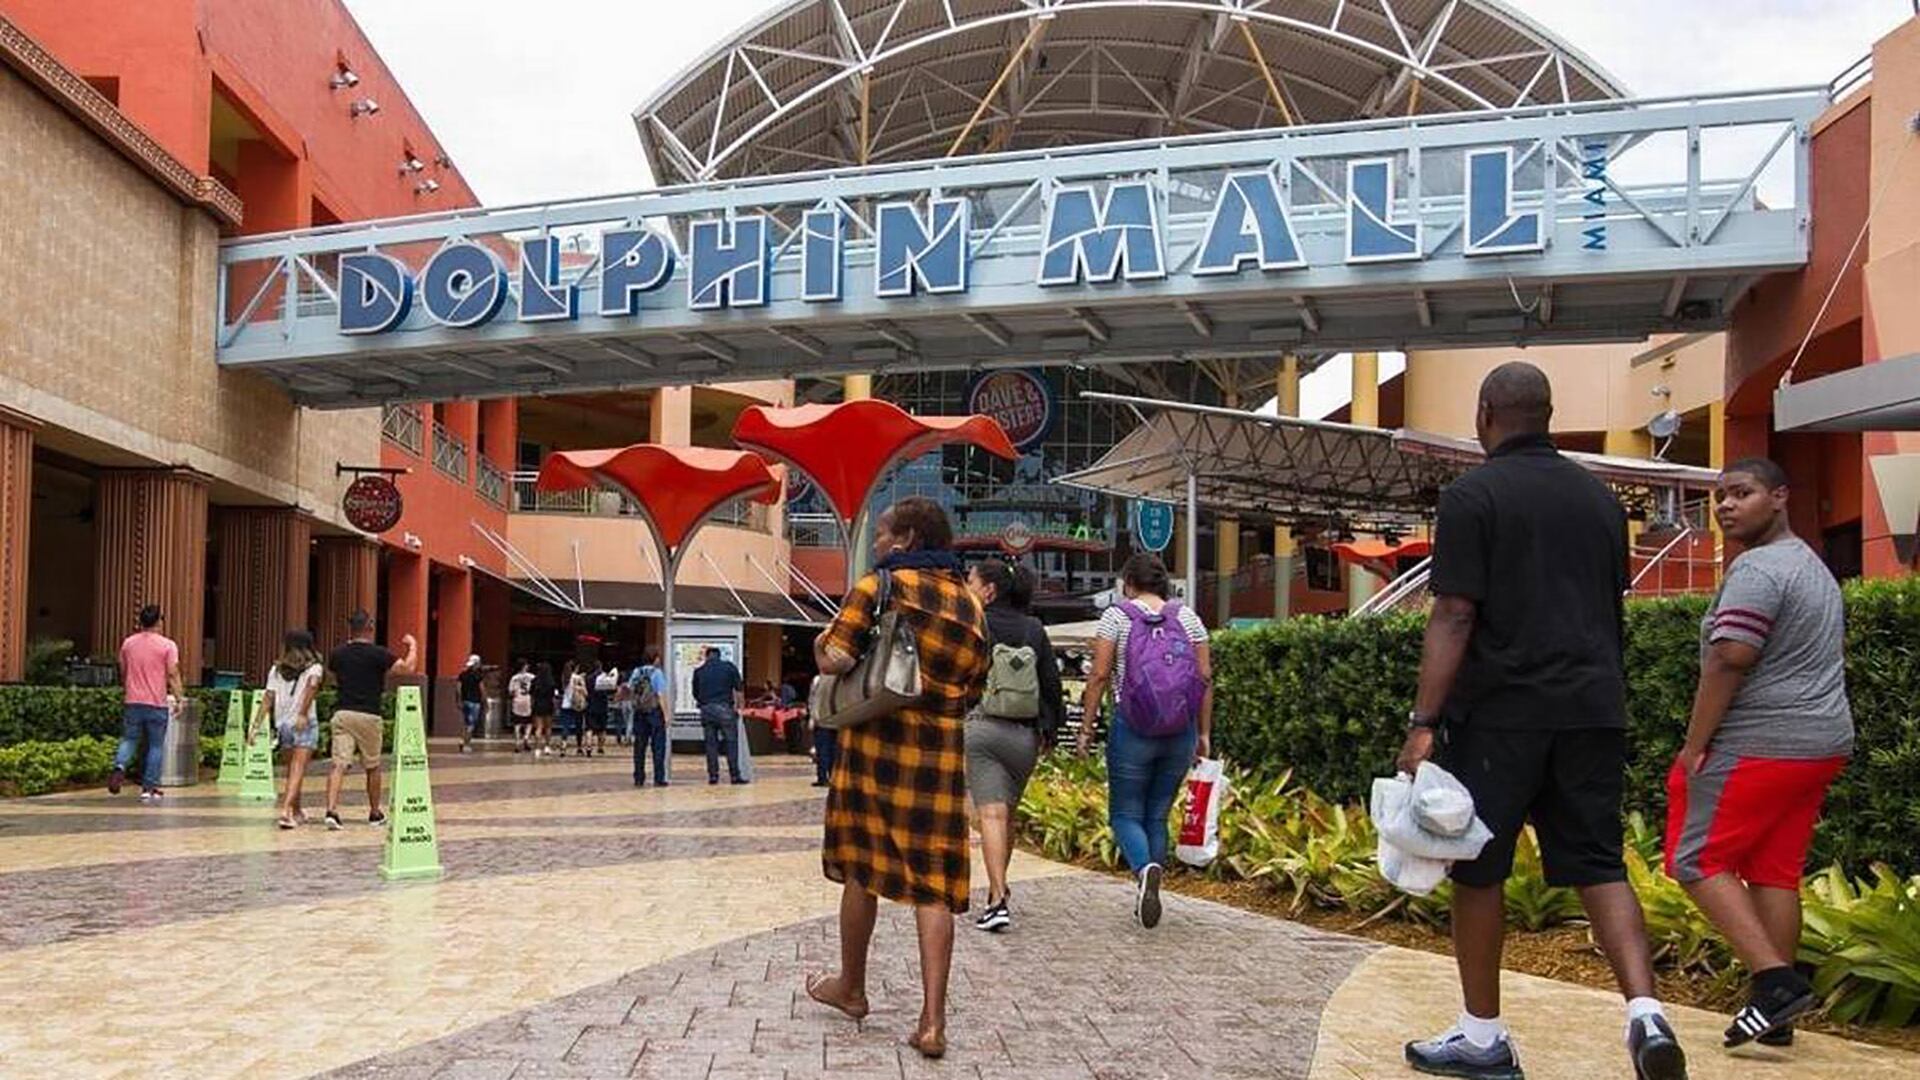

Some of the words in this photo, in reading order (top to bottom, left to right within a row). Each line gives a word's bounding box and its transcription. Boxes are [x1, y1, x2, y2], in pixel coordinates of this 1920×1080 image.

[338, 197, 969, 336] DOLPHIN
[1037, 146, 1545, 287] MALL
[1581, 144, 1607, 250] MIAMI
[979, 381, 1025, 413] DAVE
